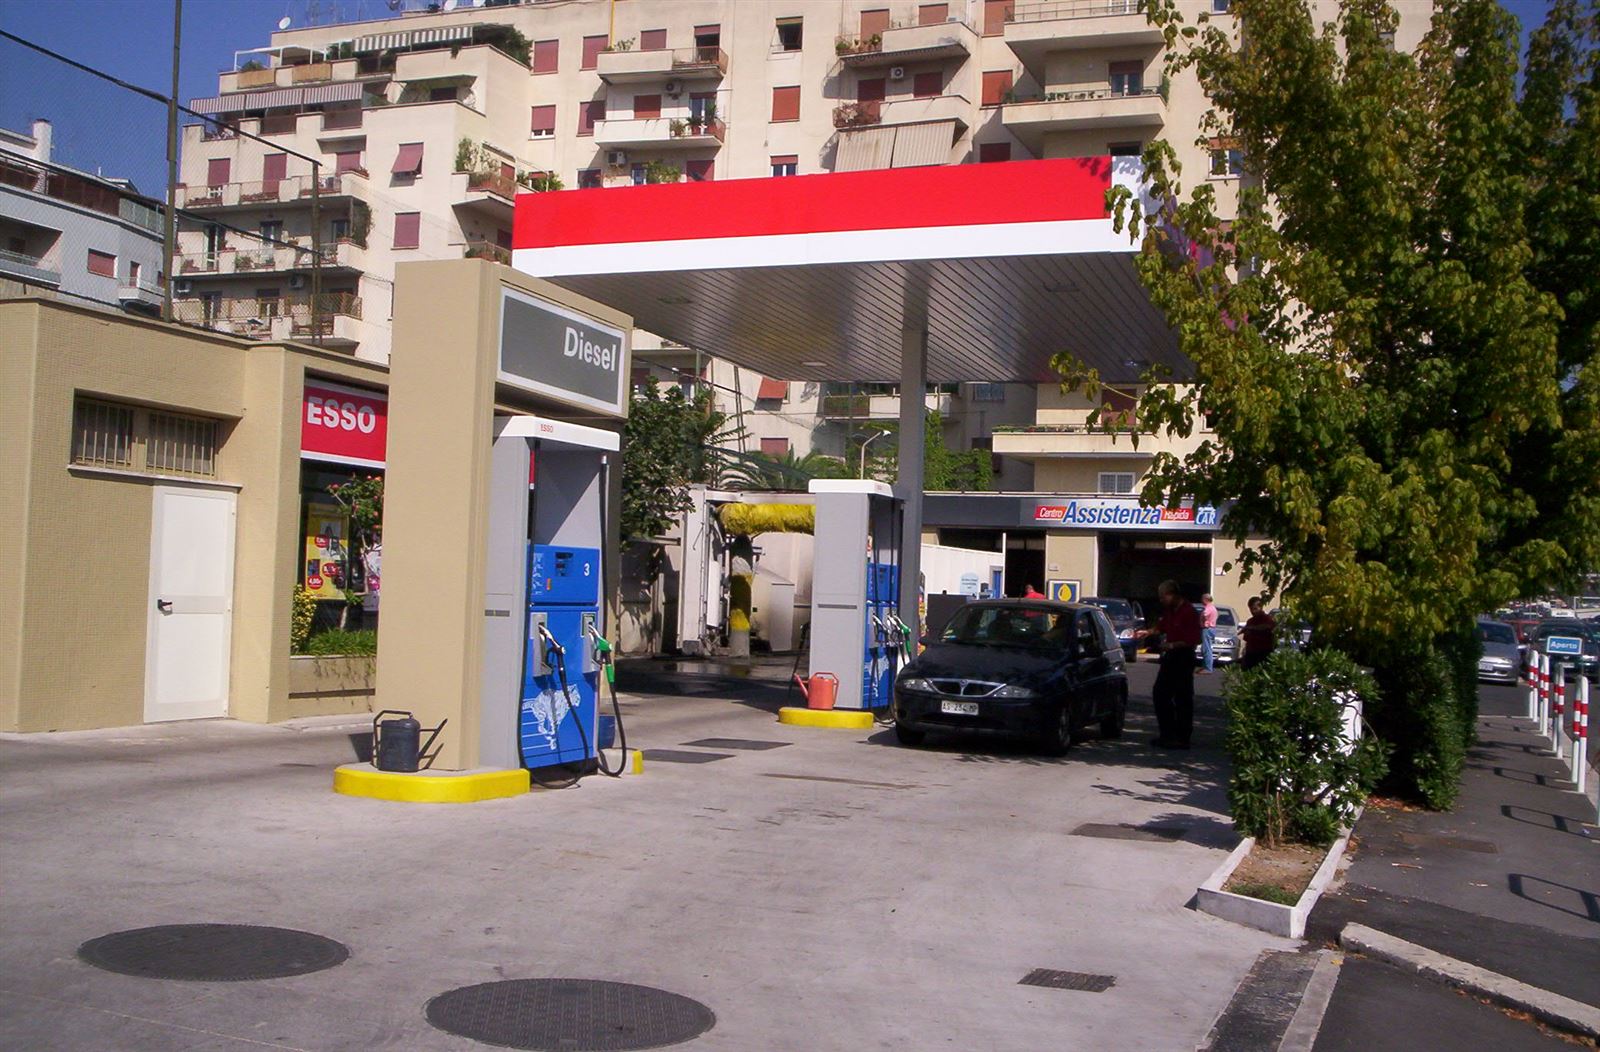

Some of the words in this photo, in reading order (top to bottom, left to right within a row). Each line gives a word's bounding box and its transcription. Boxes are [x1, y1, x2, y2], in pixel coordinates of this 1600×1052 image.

[564, 326, 616, 371] Diesel
[307, 396, 375, 433] ESSO
[541, 424, 553, 433] ESSO
[1039, 507, 1063, 518] Centro
[1062, 501, 1161, 525] Assistenza
[583, 562, 590, 576] 3
